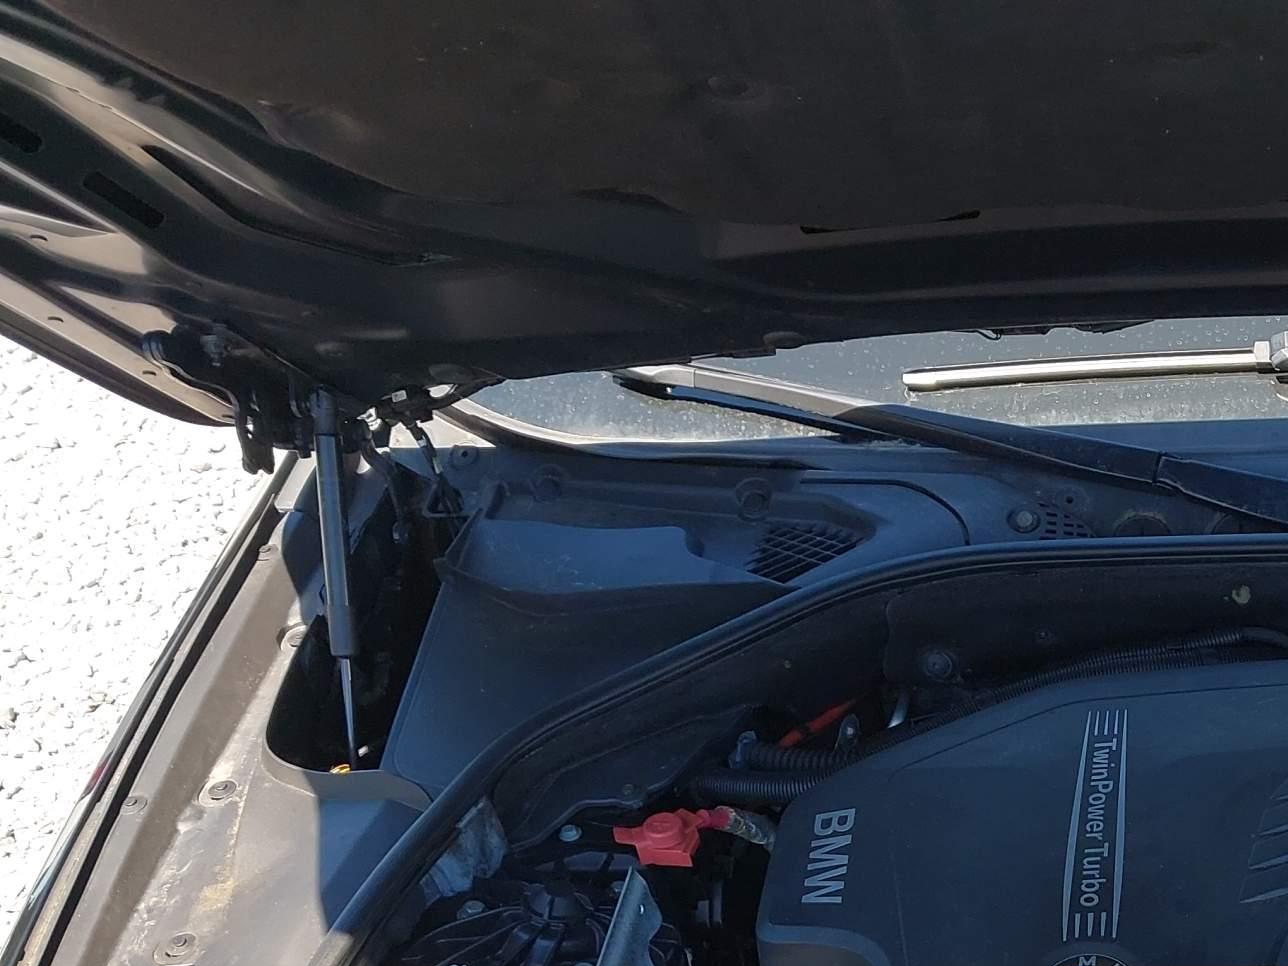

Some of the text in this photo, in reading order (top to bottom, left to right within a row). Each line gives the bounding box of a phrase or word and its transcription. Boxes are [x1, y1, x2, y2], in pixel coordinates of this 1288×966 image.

[801, 808, 856, 903] BMW
[1080, 738, 1117, 907] TwinPower Turbo
